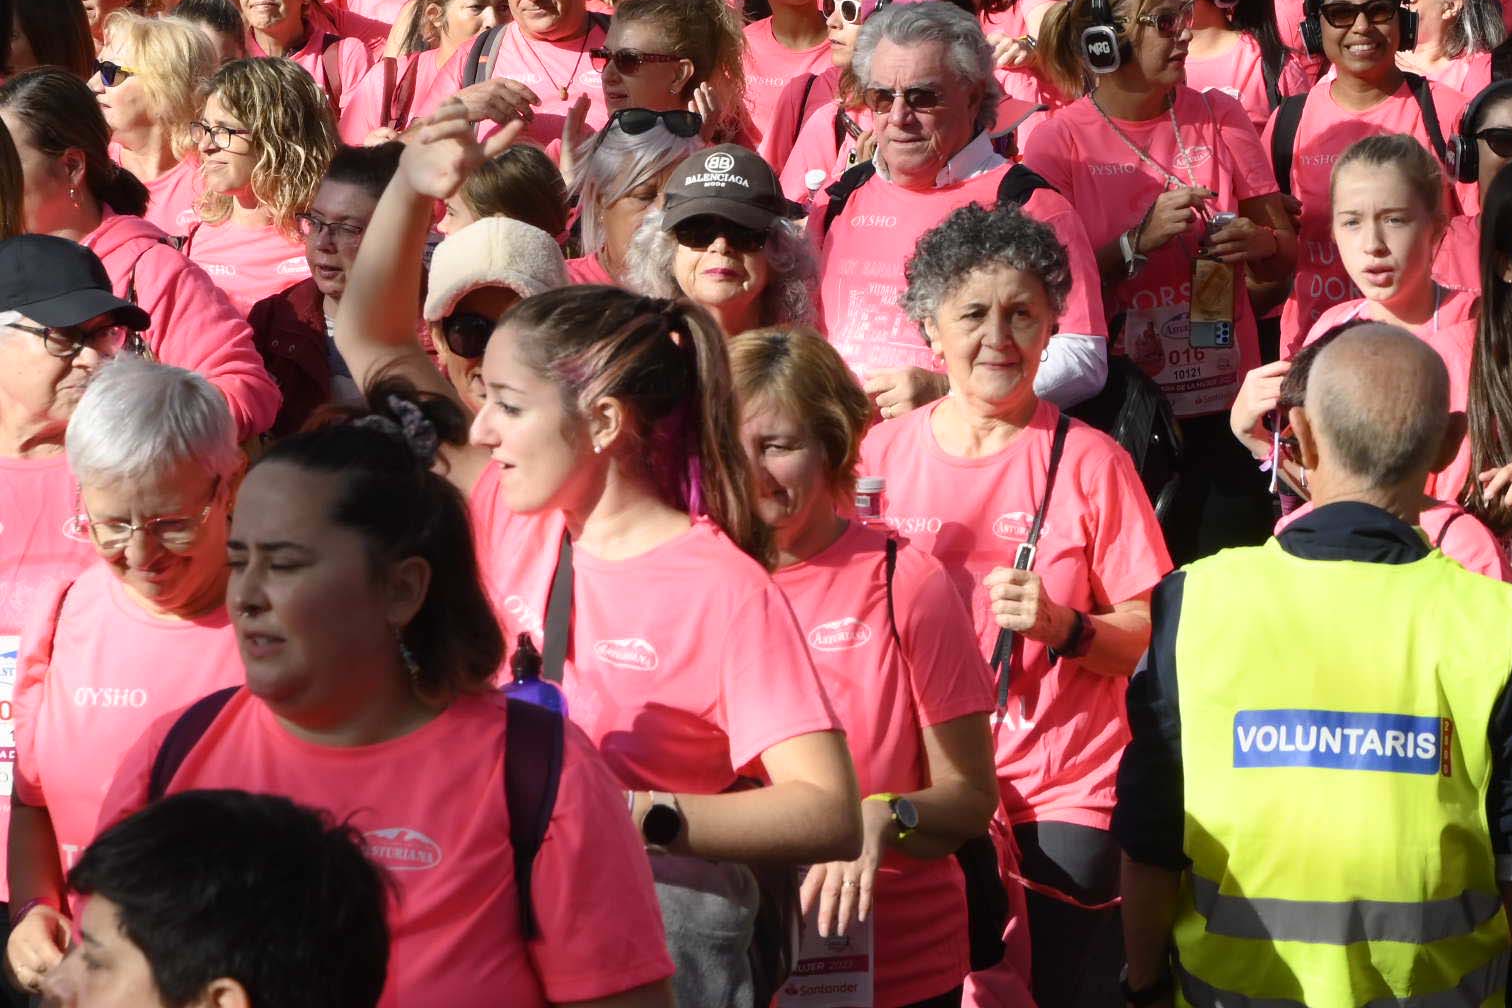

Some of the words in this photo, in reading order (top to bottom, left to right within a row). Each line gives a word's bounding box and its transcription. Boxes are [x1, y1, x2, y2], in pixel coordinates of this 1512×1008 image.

[1088, 41, 1110, 55] NRG
[685, 173, 749, 189] BALENCIAGA
[74, 687, 147, 708] OYSHO
[1237, 725, 1436, 760] VOLUNTARIS
